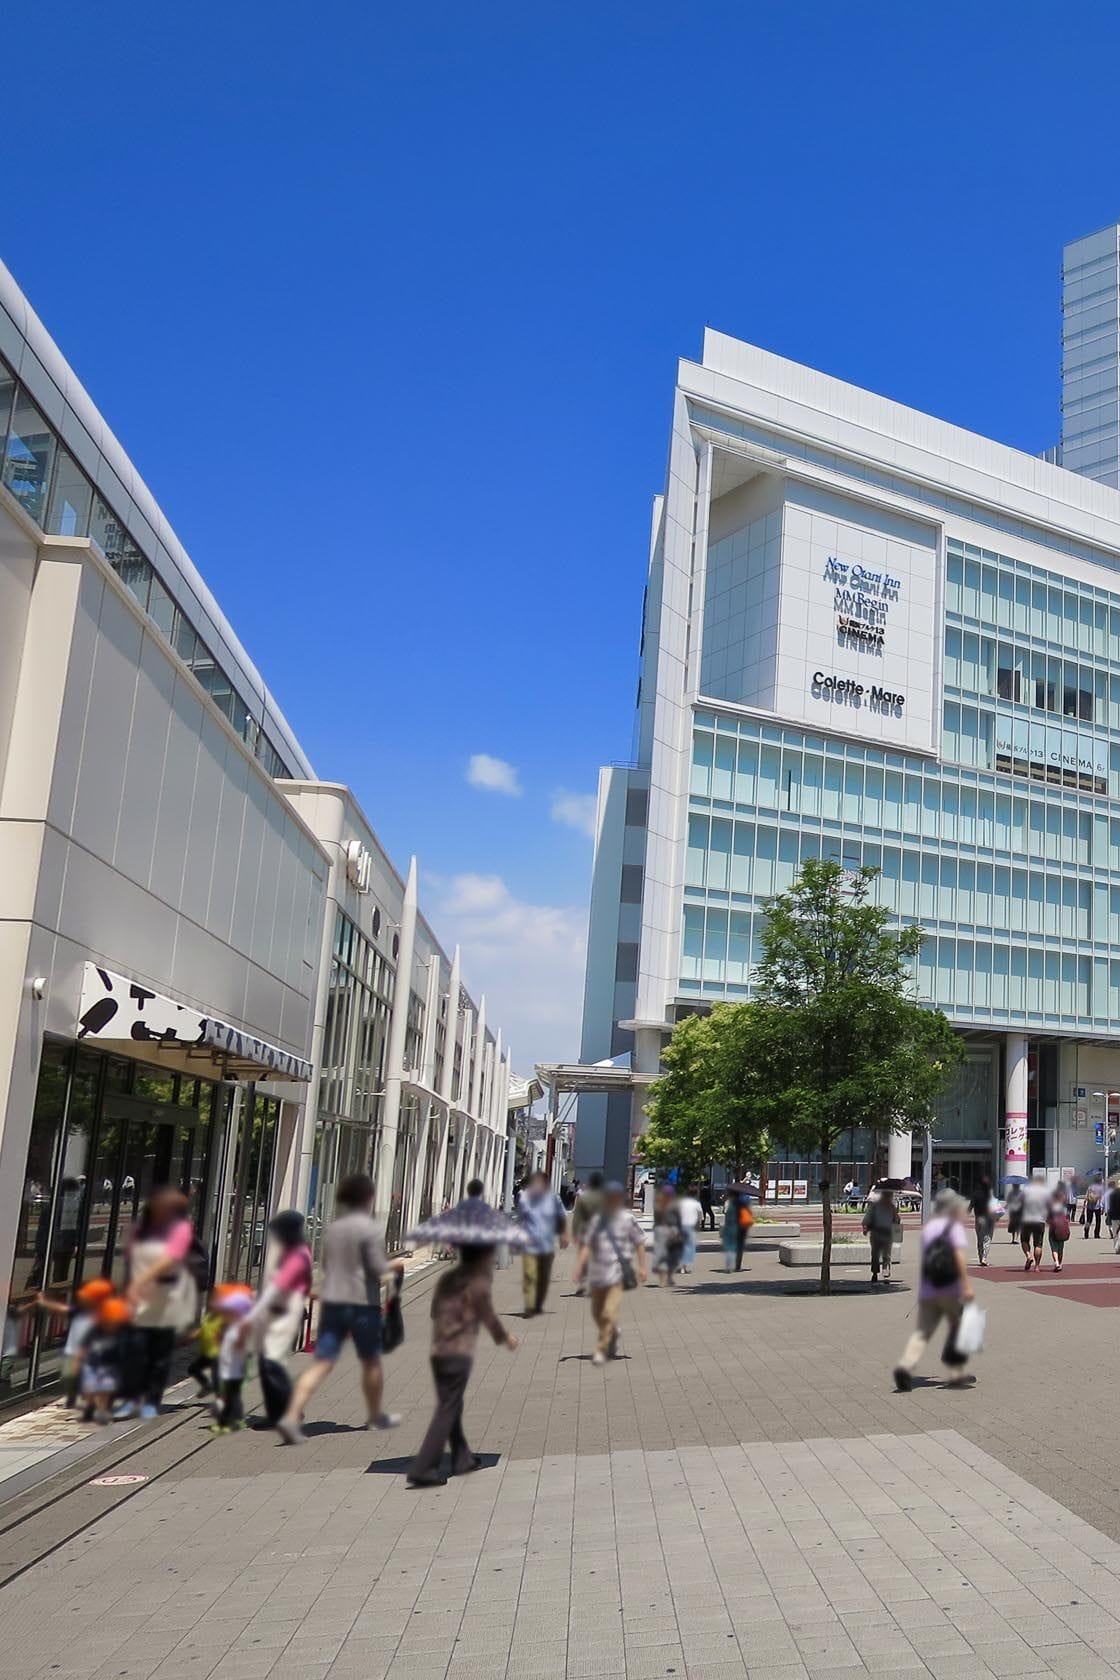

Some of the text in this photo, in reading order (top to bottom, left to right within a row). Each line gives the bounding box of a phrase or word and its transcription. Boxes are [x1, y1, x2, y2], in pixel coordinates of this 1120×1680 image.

[825, 557, 901, 589] New Otani Inn
[839, 625, 885, 645] CINEMA
[1050, 752, 1093, 769] CINEMA
